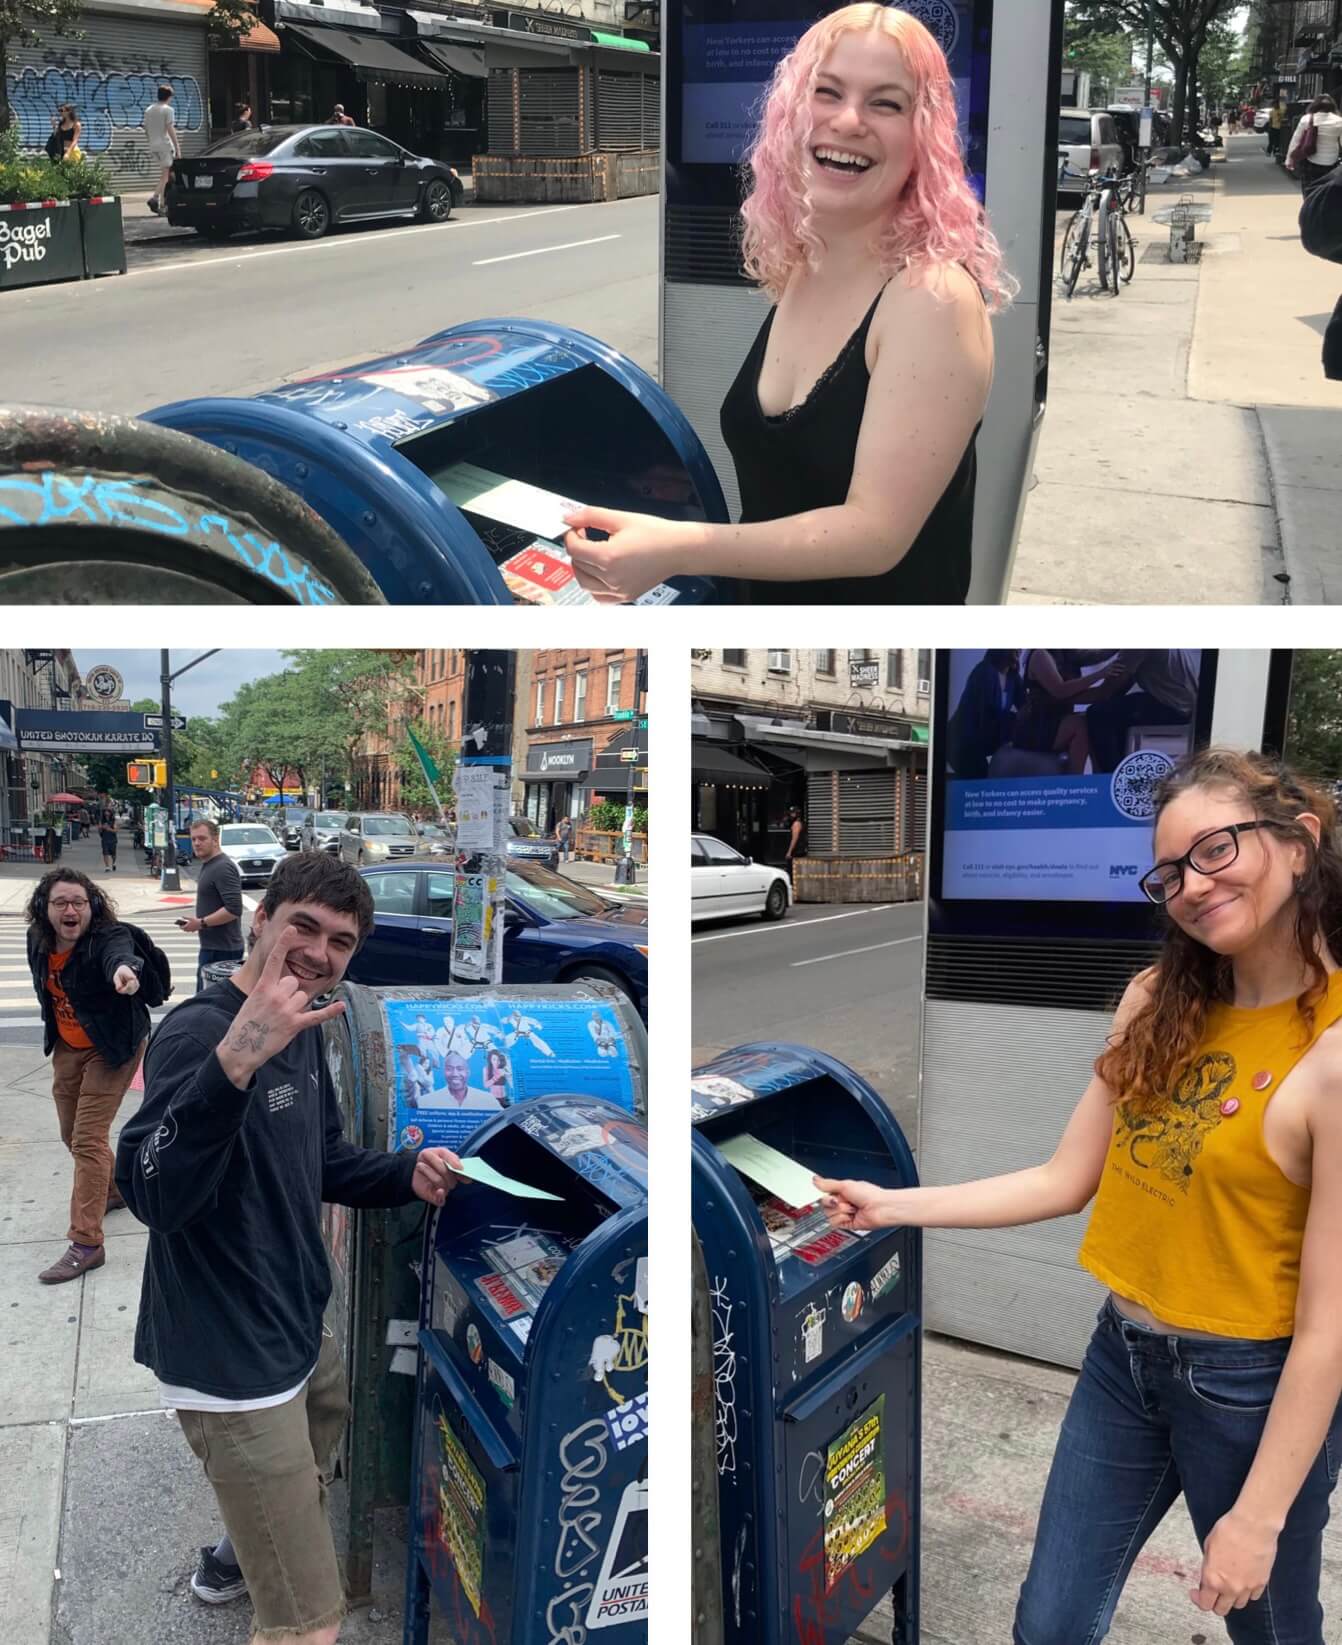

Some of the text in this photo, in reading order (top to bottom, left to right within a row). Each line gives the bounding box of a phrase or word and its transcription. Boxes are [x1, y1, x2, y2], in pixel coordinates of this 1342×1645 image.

[0, 216, 52, 245] Bagel
[0, 240, 47, 270] Pub
[20, 729, 54, 741] UNITED
[104, 732, 140, 743] KARATE
[964, 786, 1099, 799] New Yorkers can access quality services
[974, 799, 984, 808] low
[993, 799, 1003, 808] no
[1003, 799, 1017, 807] cost
[1018, 798, 1026, 807] to
[1026, 797, 1046, 806] make
[1047, 797, 1088, 807] pregnancy,
[982, 810, 996, 818] and
[996, 808, 1021, 818] infancy
[1109, 865, 1138, 876] NYC
[831, 1438, 877, 1490] CONCERT
[596, 1599, 648, 1619] POSTA
